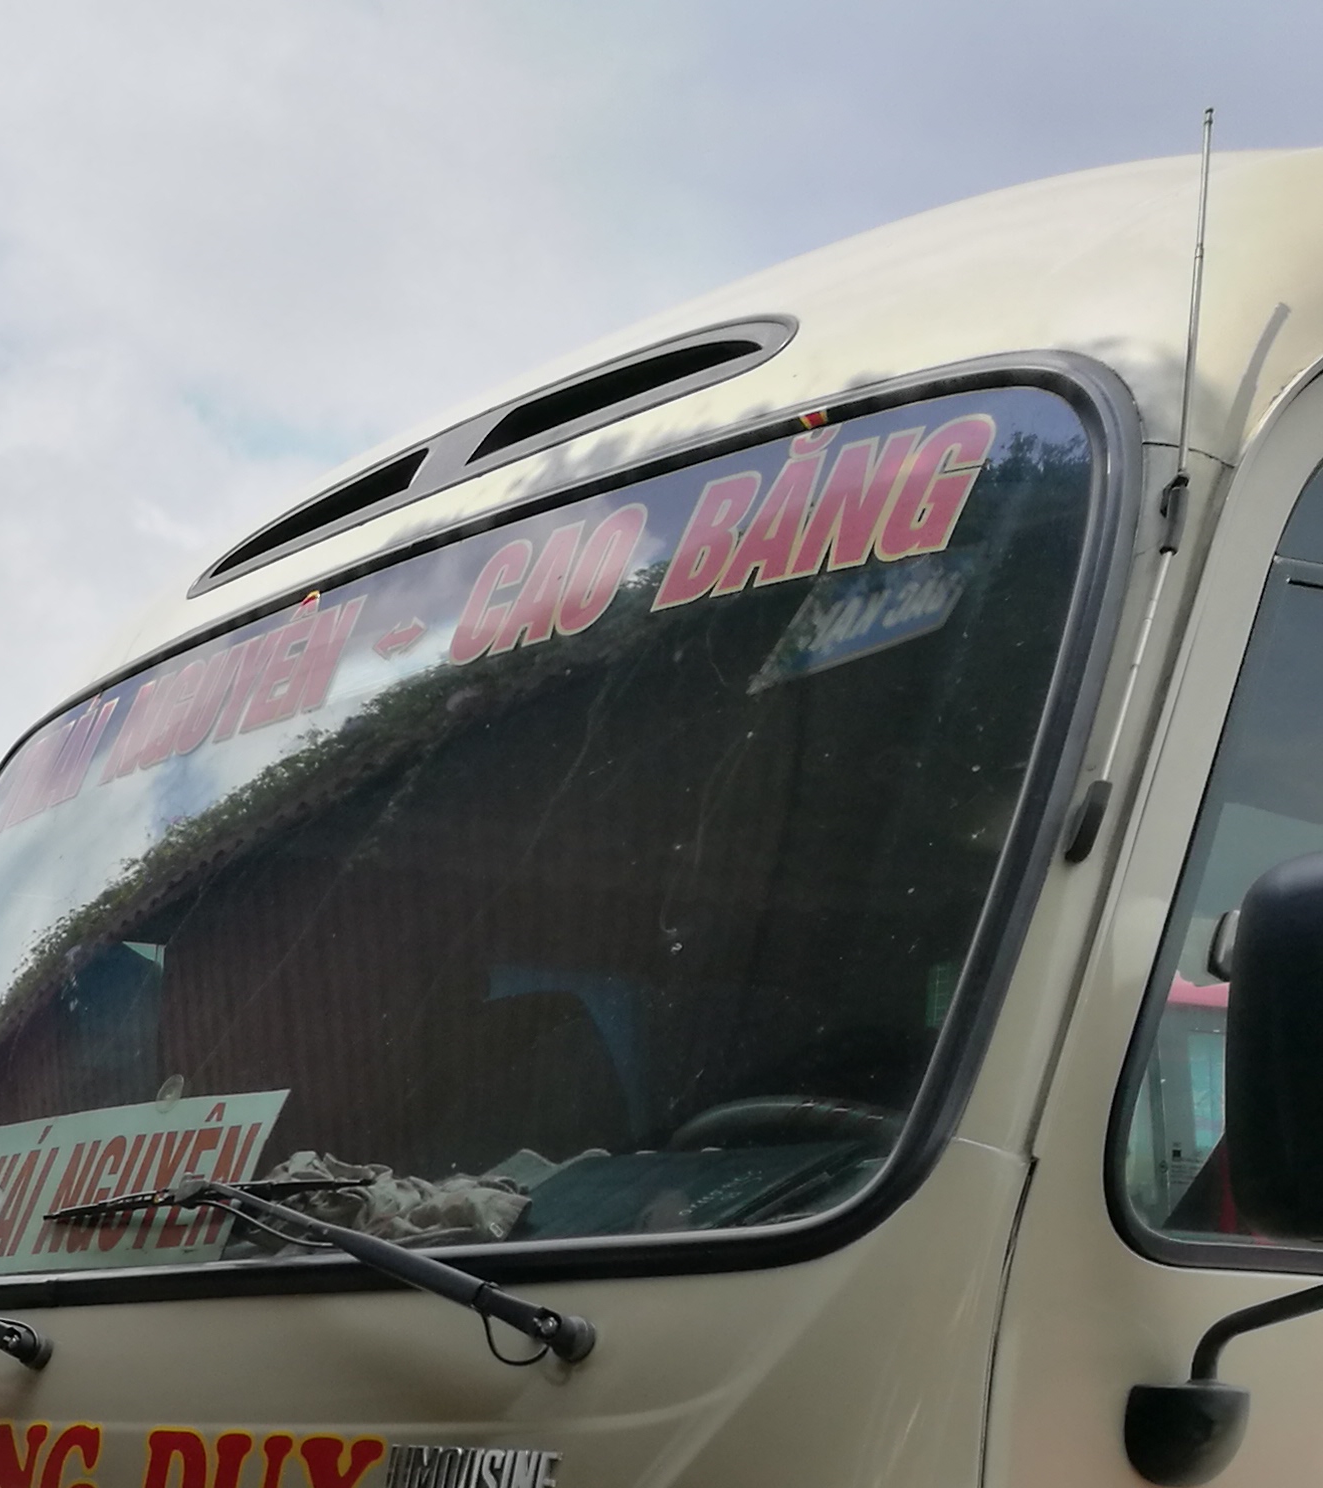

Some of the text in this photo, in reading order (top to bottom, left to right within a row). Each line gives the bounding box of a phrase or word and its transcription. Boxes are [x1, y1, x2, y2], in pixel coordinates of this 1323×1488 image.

[98, 590, 367, 786] NGUYÊN
[450, 502, 647, 666] CAO
[31, 1103, 263, 1255] NGUYÊN
